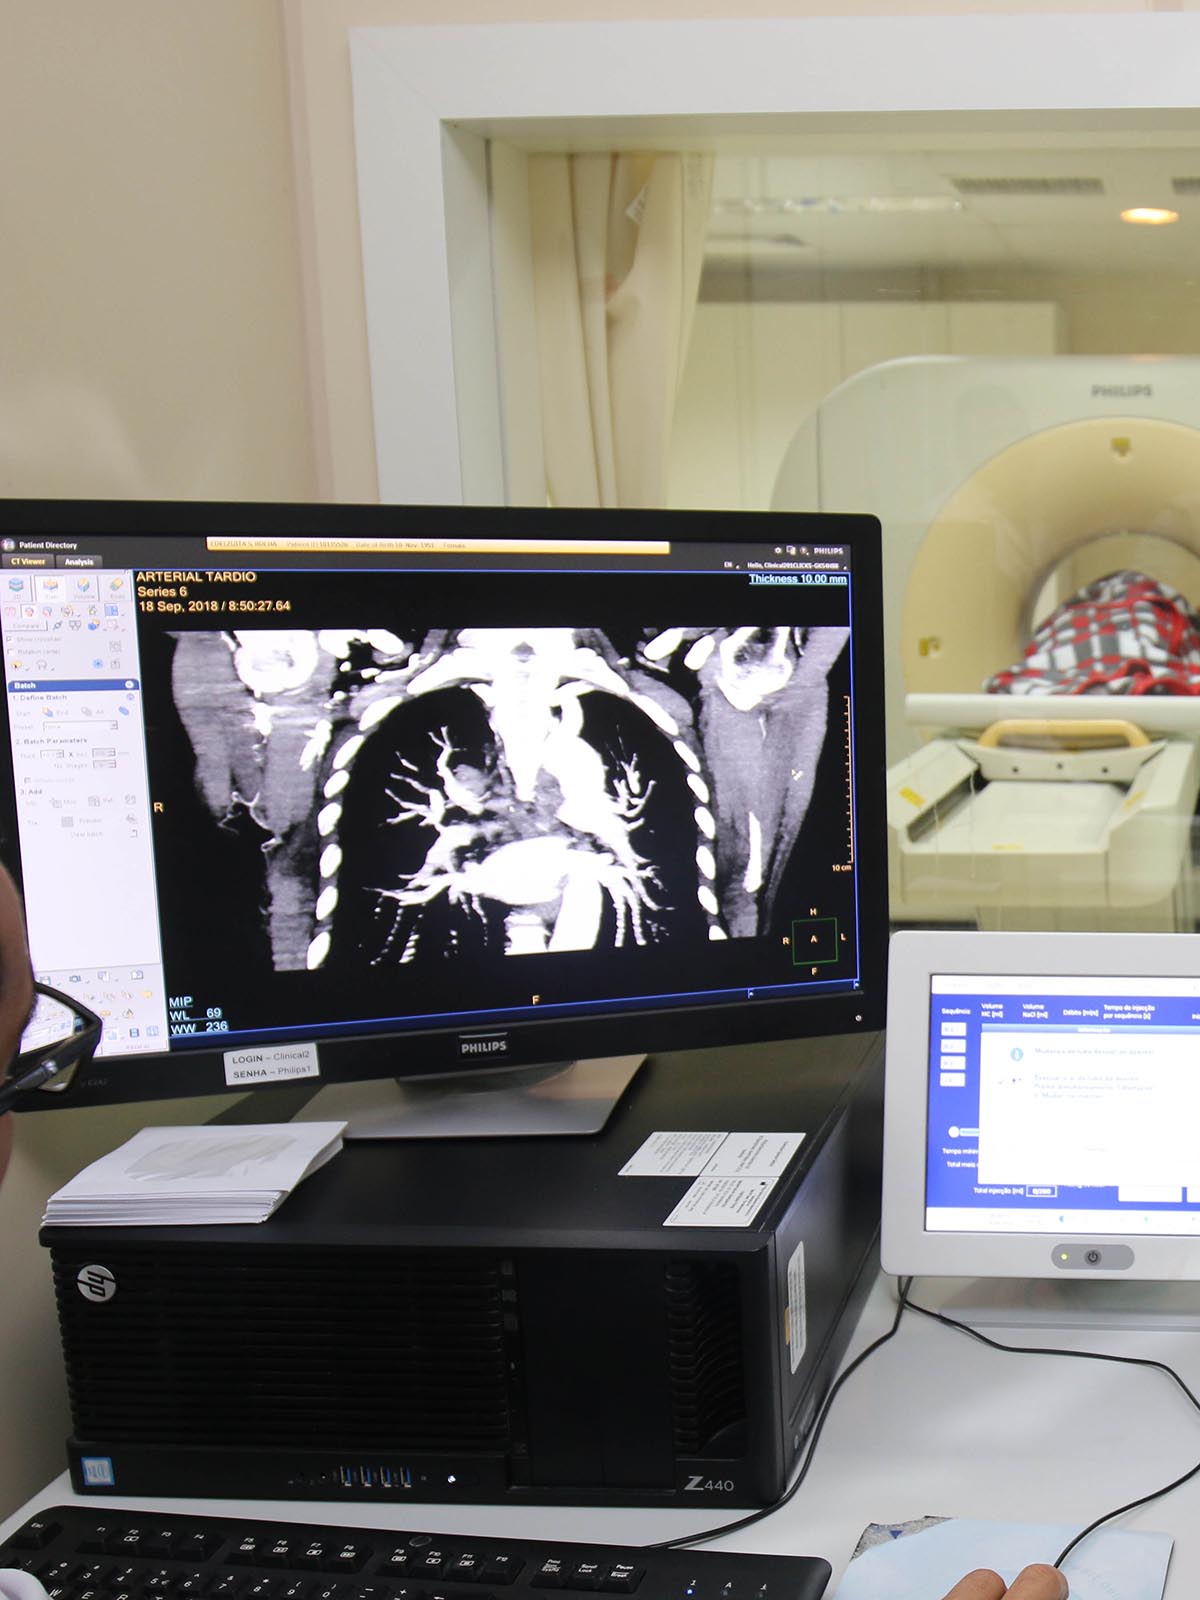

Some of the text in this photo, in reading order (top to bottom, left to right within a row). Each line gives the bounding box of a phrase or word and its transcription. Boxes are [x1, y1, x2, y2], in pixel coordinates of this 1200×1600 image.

[20, 541, 77, 551] Patient Directory
[814, 547, 844, 555] PHILIPS
[11, 558, 46, 566] CT Viewer
[65, 558, 94, 566] Analysis
[136, 571, 256, 583] ARTERIAL TARDIO
[749, 574, 848, 585] Thickness 10.00 mm
[137, 586, 177, 597] Series
[179, 586, 188, 597] 6
[139, 601, 154, 612] 18
[157, 601, 185, 614] Sep,
[188, 601, 218, 612] 2018
[228, 600, 291, 612] 8:50:27.64
[153, 802, 164, 813] R
[832, 864, 840, 872] 10
[809, 908, 817, 916] H
[782, 937, 790, 945] R
[810, 935, 818, 943] A
[840, 933, 847, 941] L
[811, 967, 817, 976] F
[169, 996, 193, 1008] MIP
[532, 995, 540, 1005] F
[1022, 1003, 1044, 1011] Volume
[1103, 1004, 1121, 1012] Tempo
[170, 1008, 222, 1021] WL 69
[171, 1021, 228, 1035] WW 236
[461, 1040, 508, 1054] PHILIPS
[232, 1050, 310, 1065] LOGIN Clinical2
[233, 1065, 311, 1079] SENHA Philips1
[942, 1147, 962, 1155] Tempo
[81, 1591, 94, 1600] E
